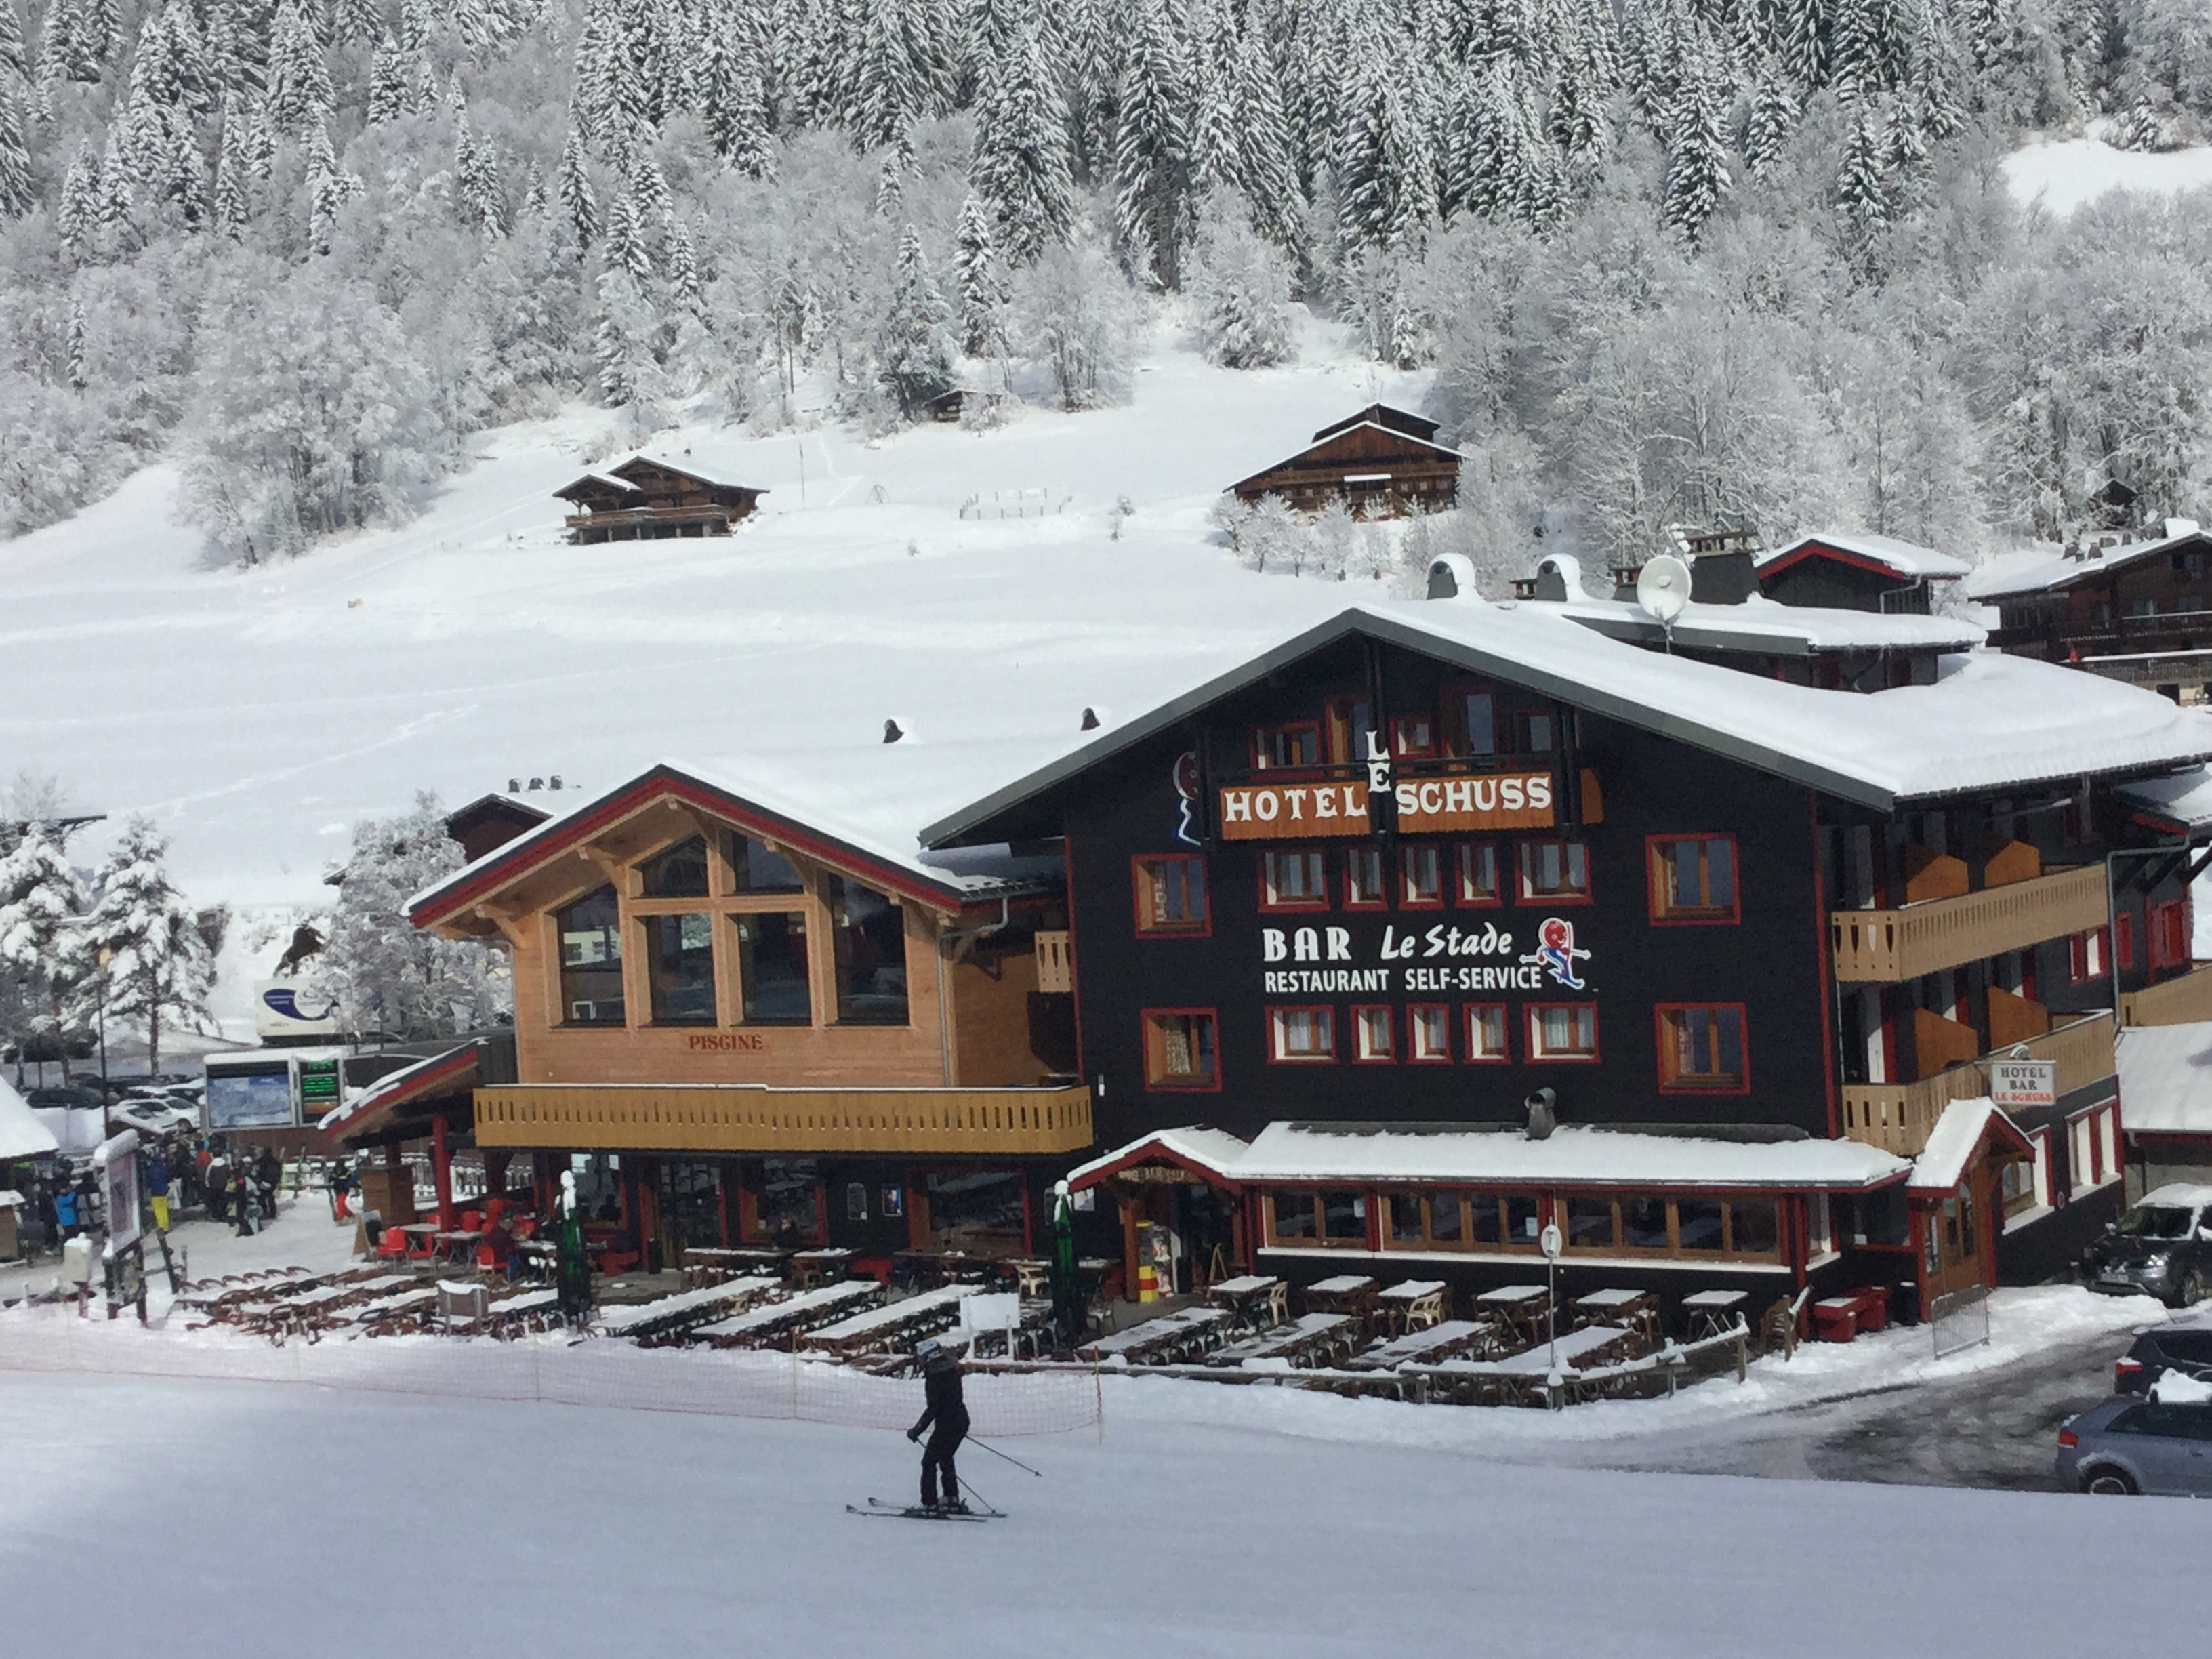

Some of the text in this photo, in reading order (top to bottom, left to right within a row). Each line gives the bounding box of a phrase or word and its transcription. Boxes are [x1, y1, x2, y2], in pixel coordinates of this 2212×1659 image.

[1224, 730, 1552, 822] HOTEL LE SCHUSS
[1262, 921, 1513, 962] BAR Le Stade
[1265, 966, 1542, 992] RESTAURANT SELF-SERVICE
[689, 1033, 763, 1050] PISCINE
[2001, 1067, 2046, 1078] HOTEL
[2009, 1080, 2038, 1090] BAR
